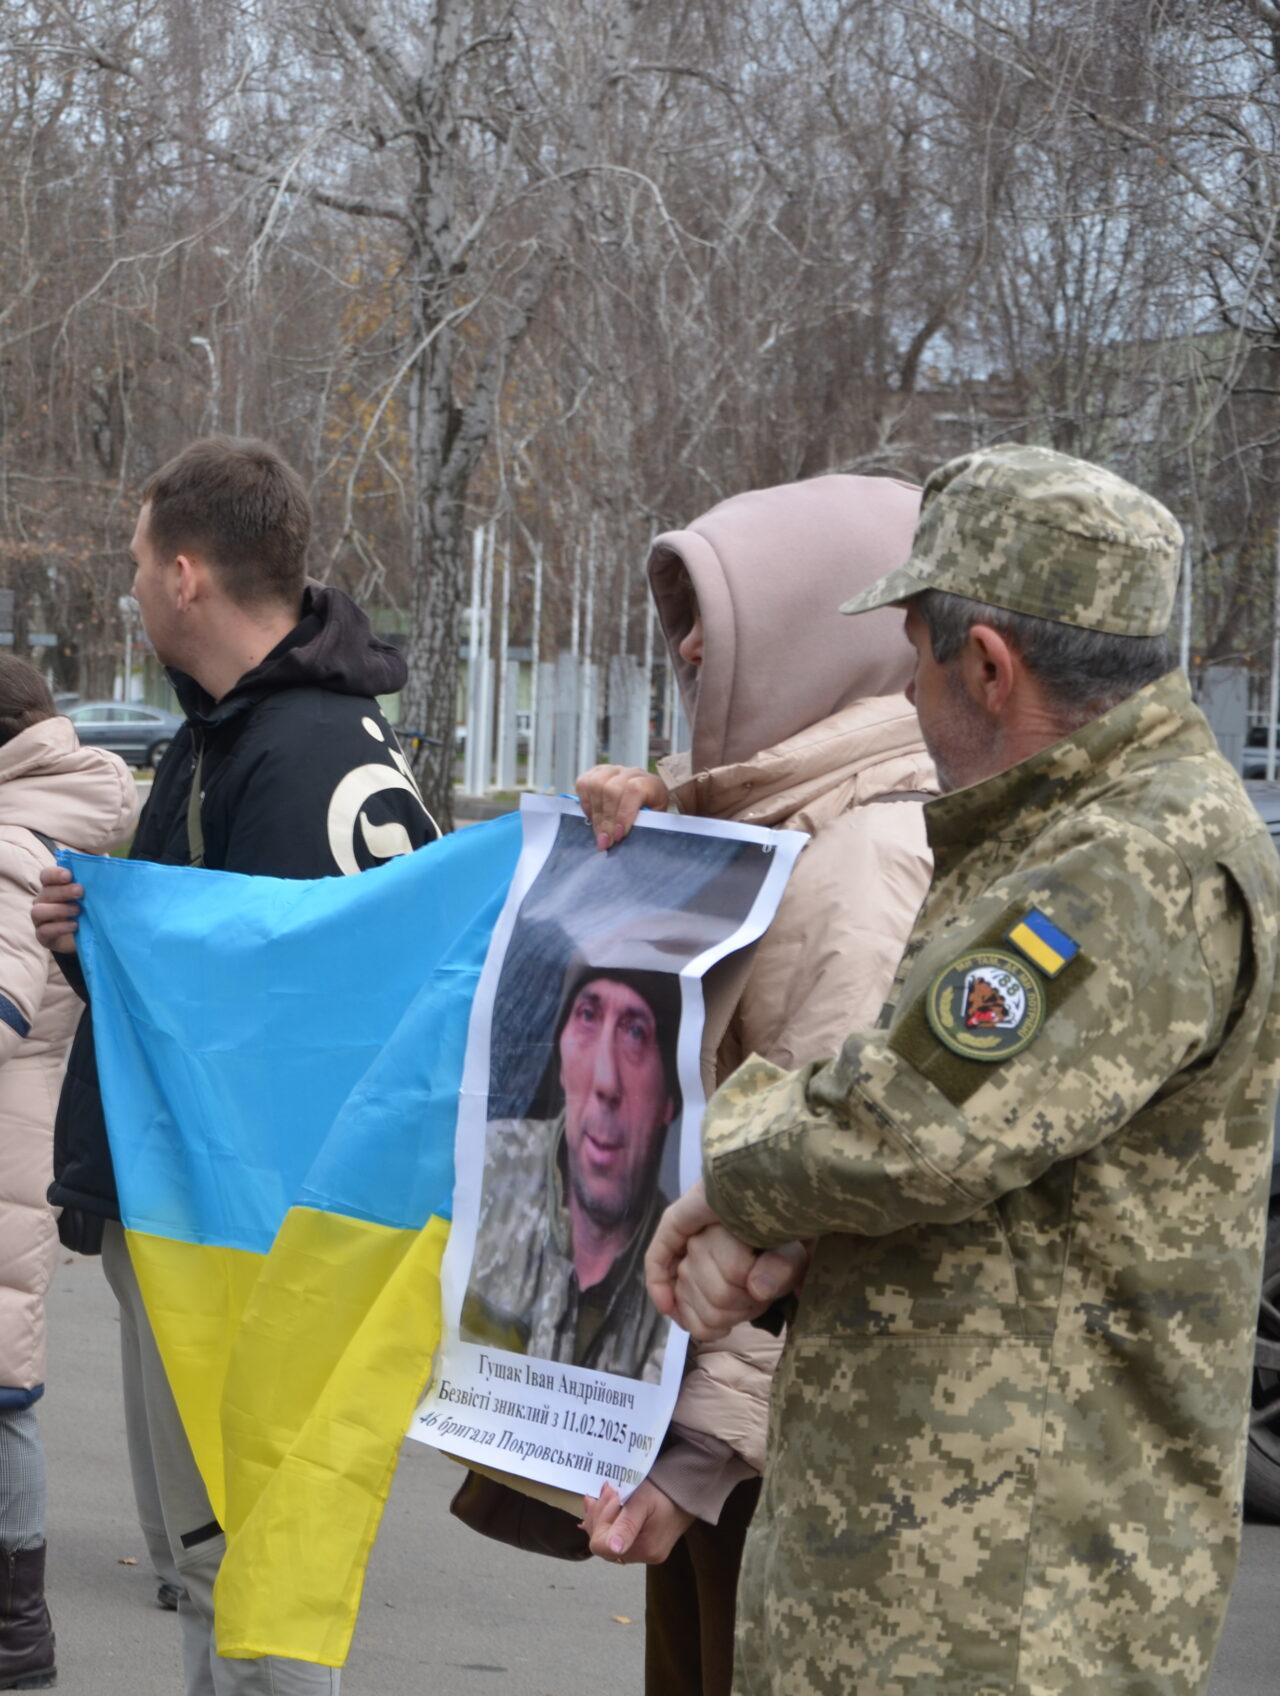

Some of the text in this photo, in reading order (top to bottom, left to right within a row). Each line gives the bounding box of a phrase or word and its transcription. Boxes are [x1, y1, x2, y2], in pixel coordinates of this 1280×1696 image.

[525, 1364, 554, 1391] Іван
[559, 1374, 635, 1411] Андрійович
[437, 1415, 497, 1446] бригада
[496, 1429, 594, 1474] Покровський
[438, 1380, 656, 1458] Безвісті зниклий з 11.02.2025 року
